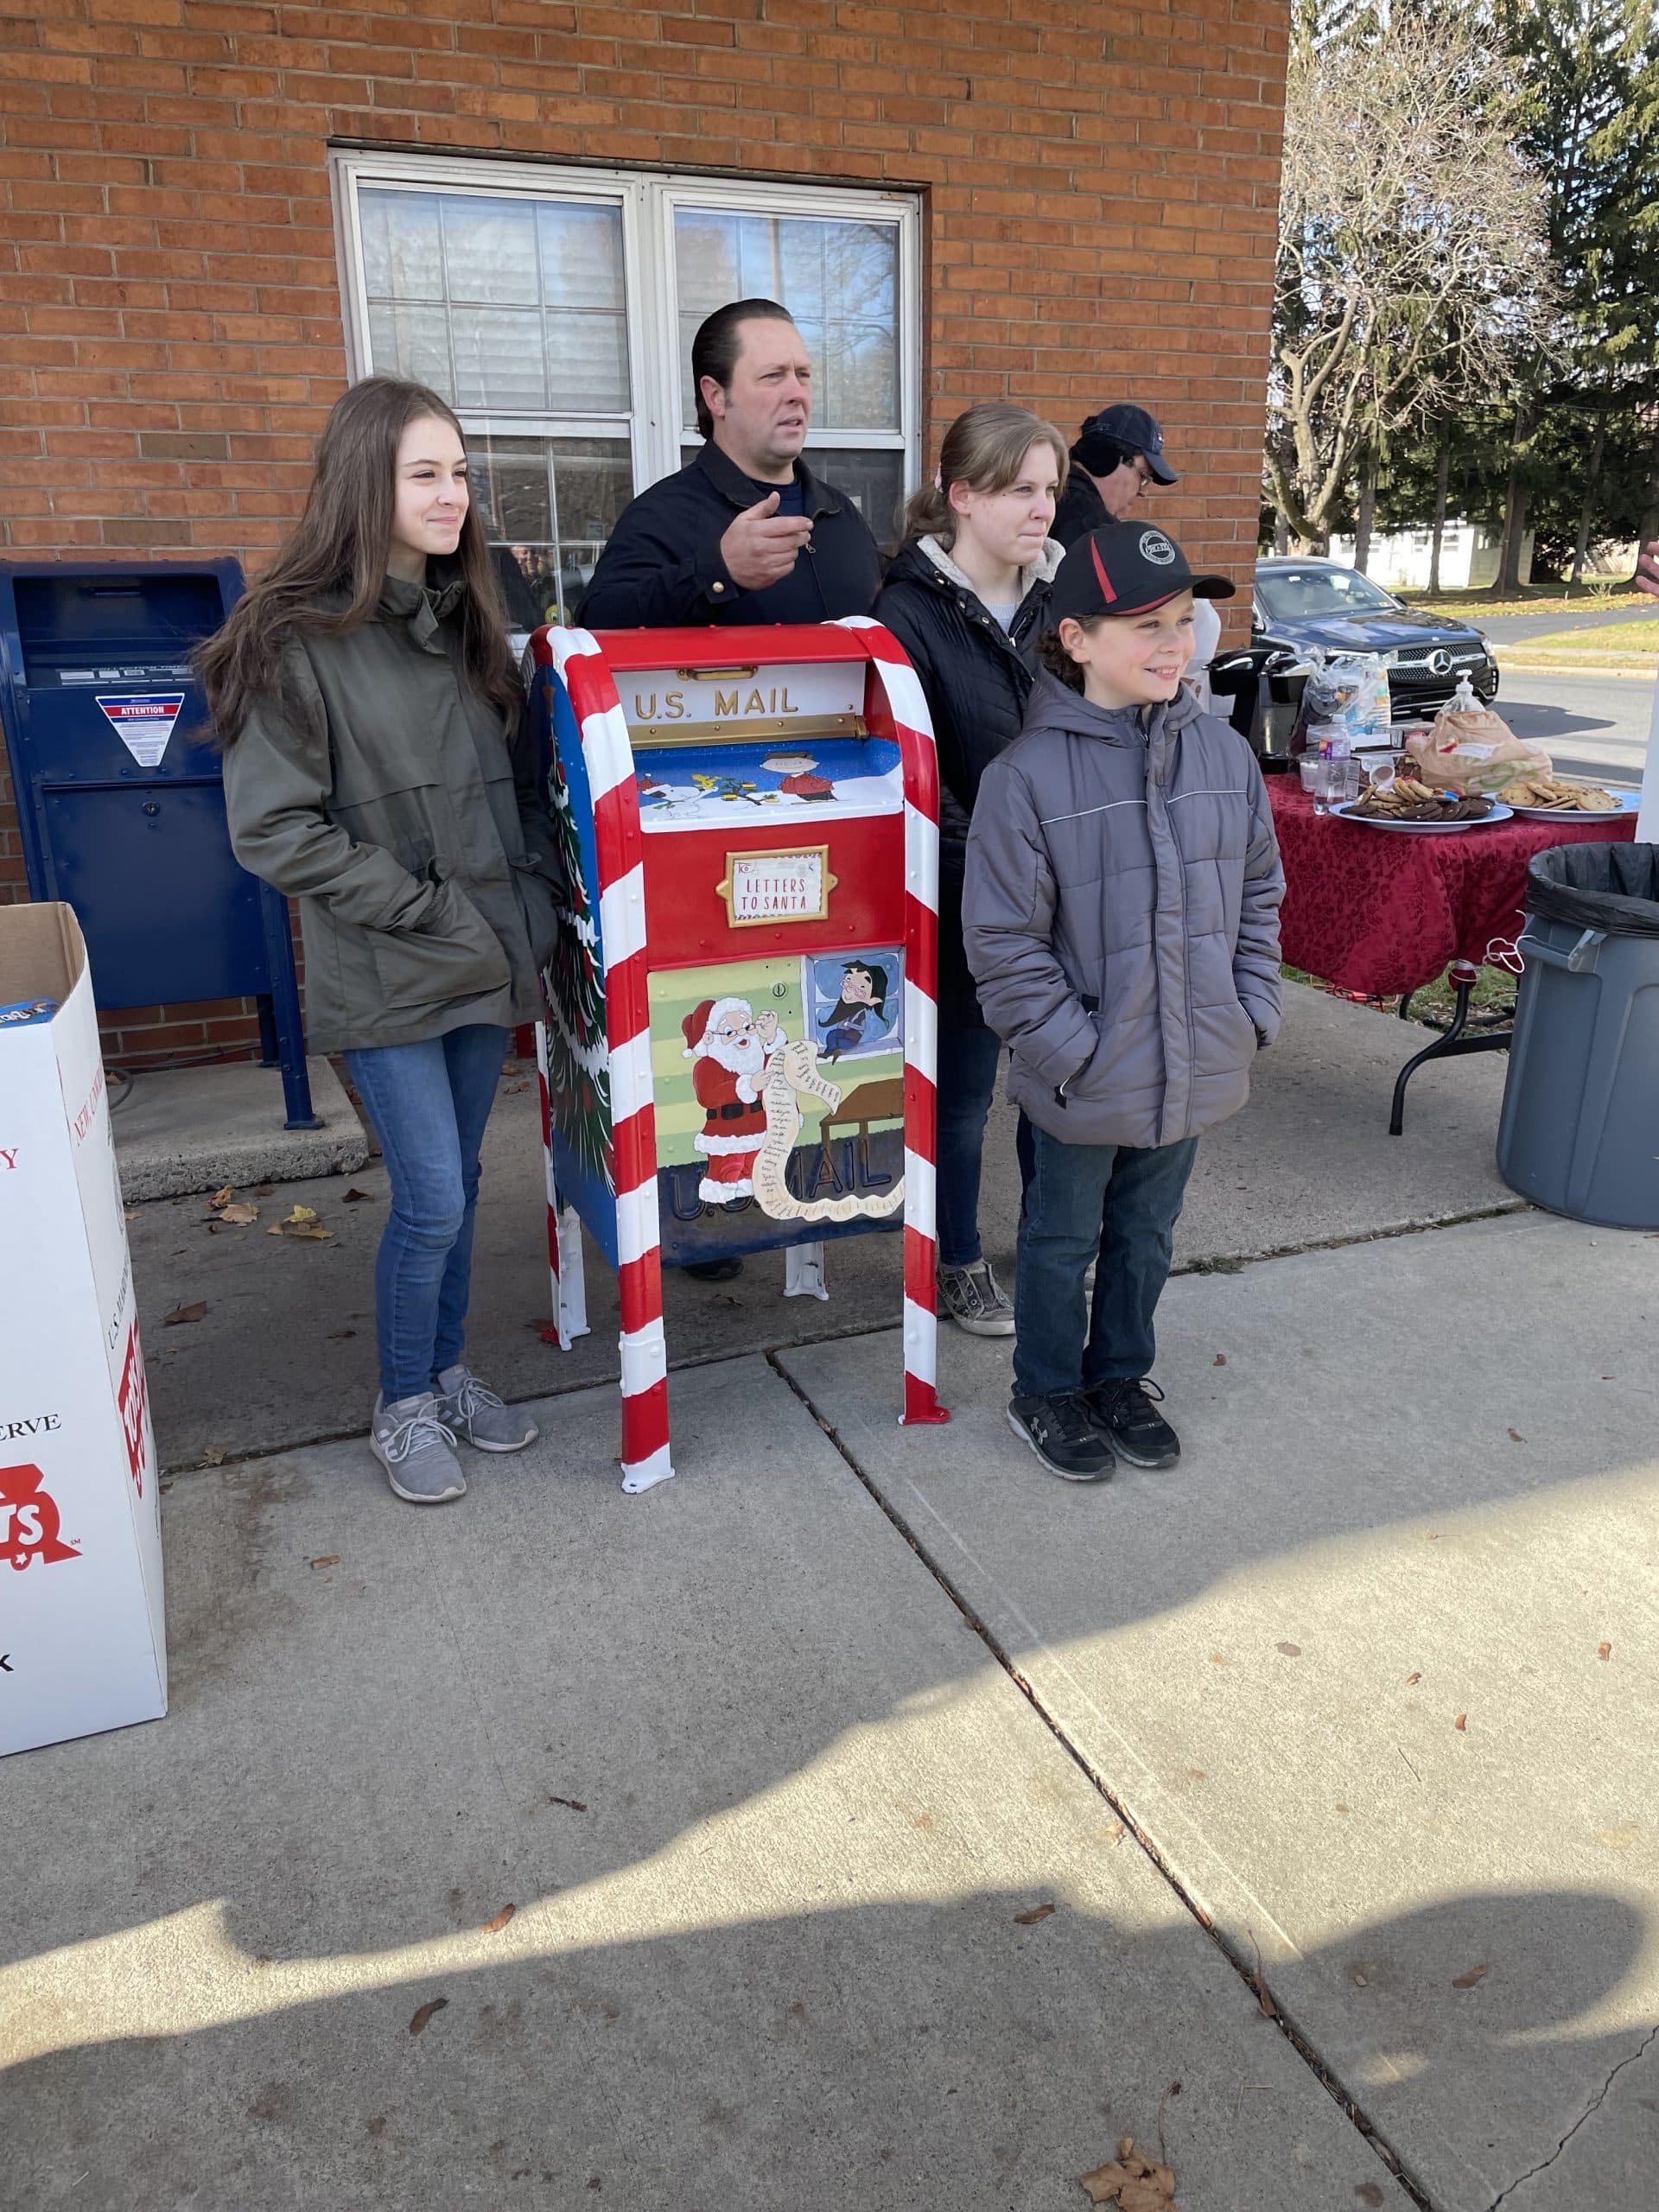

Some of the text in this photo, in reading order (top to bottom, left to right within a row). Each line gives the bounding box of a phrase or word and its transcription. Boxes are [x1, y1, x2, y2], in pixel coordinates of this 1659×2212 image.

[121, 706, 164, 715] ATTENTION
[636, 688, 798, 719] U.S. MAIL
[747, 878, 804, 893] LETTERS
[741, 896, 806, 910] TO SANTA
